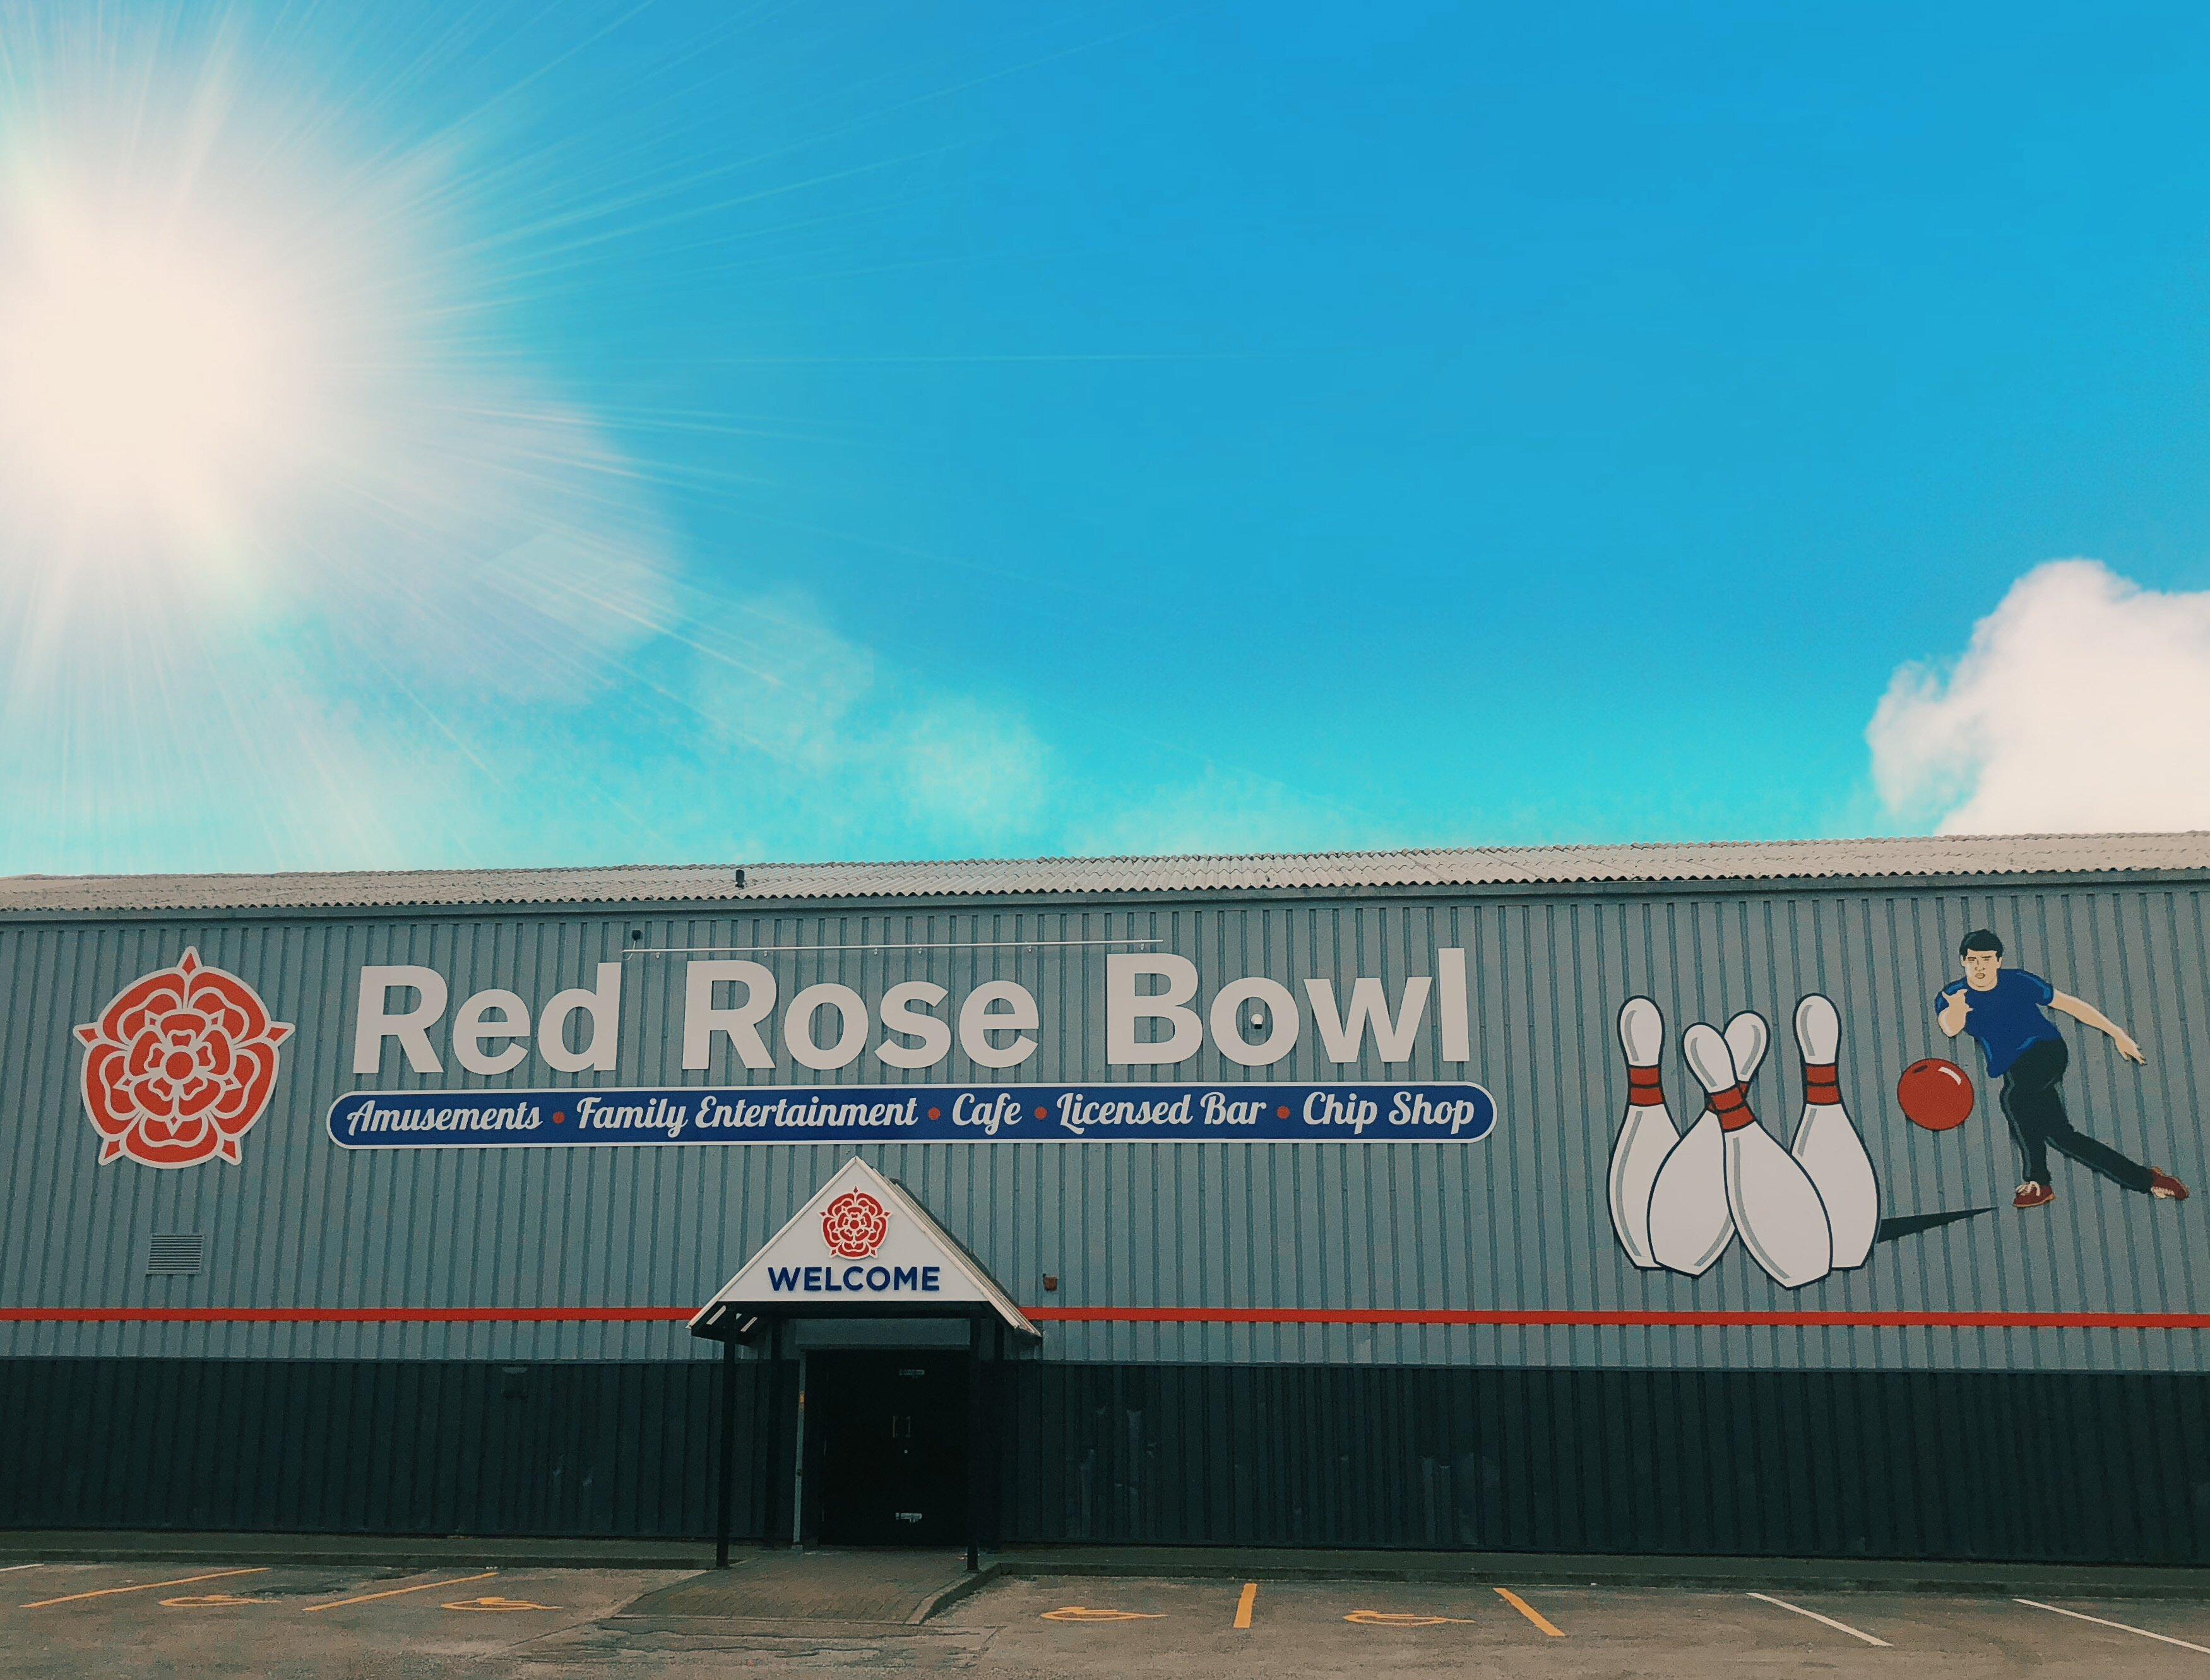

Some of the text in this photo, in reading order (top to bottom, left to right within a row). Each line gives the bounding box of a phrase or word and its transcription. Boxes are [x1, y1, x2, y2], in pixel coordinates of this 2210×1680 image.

[352, 947, 1470, 1075] Red Rose Bowl
[347, 1091, 1475, 1138] Amusements Family Entertainment Cafe Licensed Bar Chip Shop
[767, 1266, 941, 1292] WELCOME
